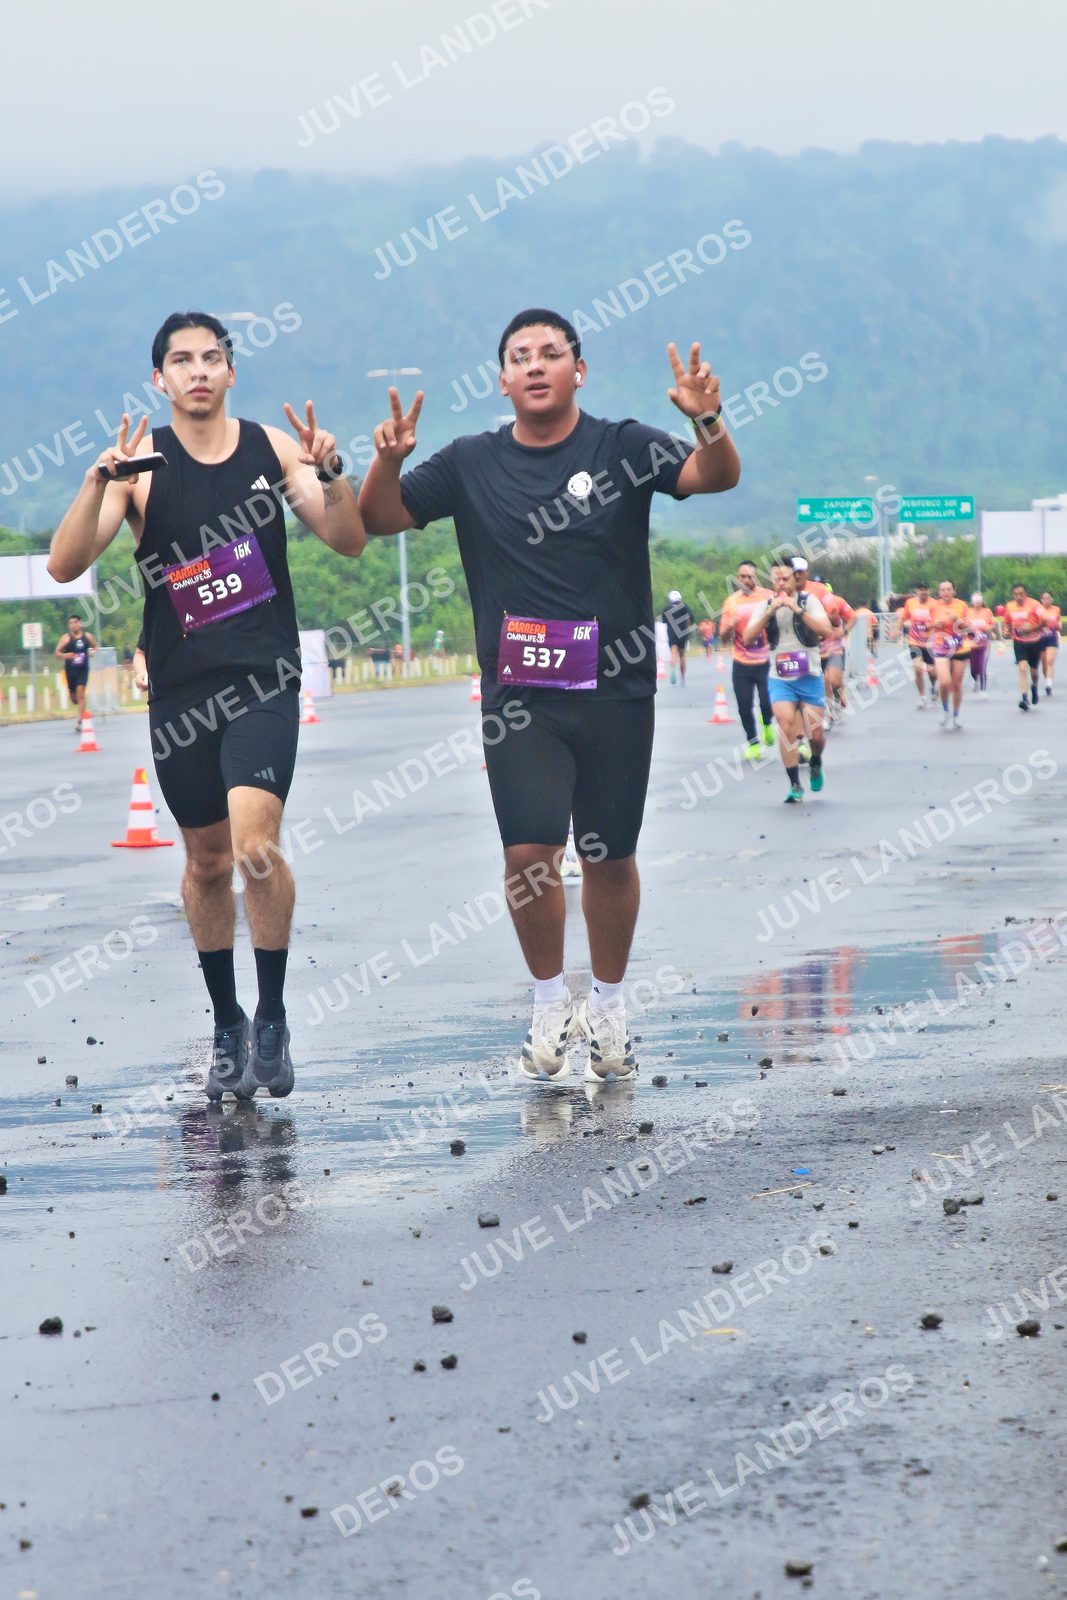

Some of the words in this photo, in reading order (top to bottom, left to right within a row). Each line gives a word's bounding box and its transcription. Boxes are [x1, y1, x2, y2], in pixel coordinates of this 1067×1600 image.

[233, 541, 253, 560] 16K
[169, 560, 210, 583] CARRERA
[197, 573, 243, 605] 539
[507, 620, 547, 634] CARRERA
[573, 626, 592, 640] 16K
[522, 646, 566, 669] 537
